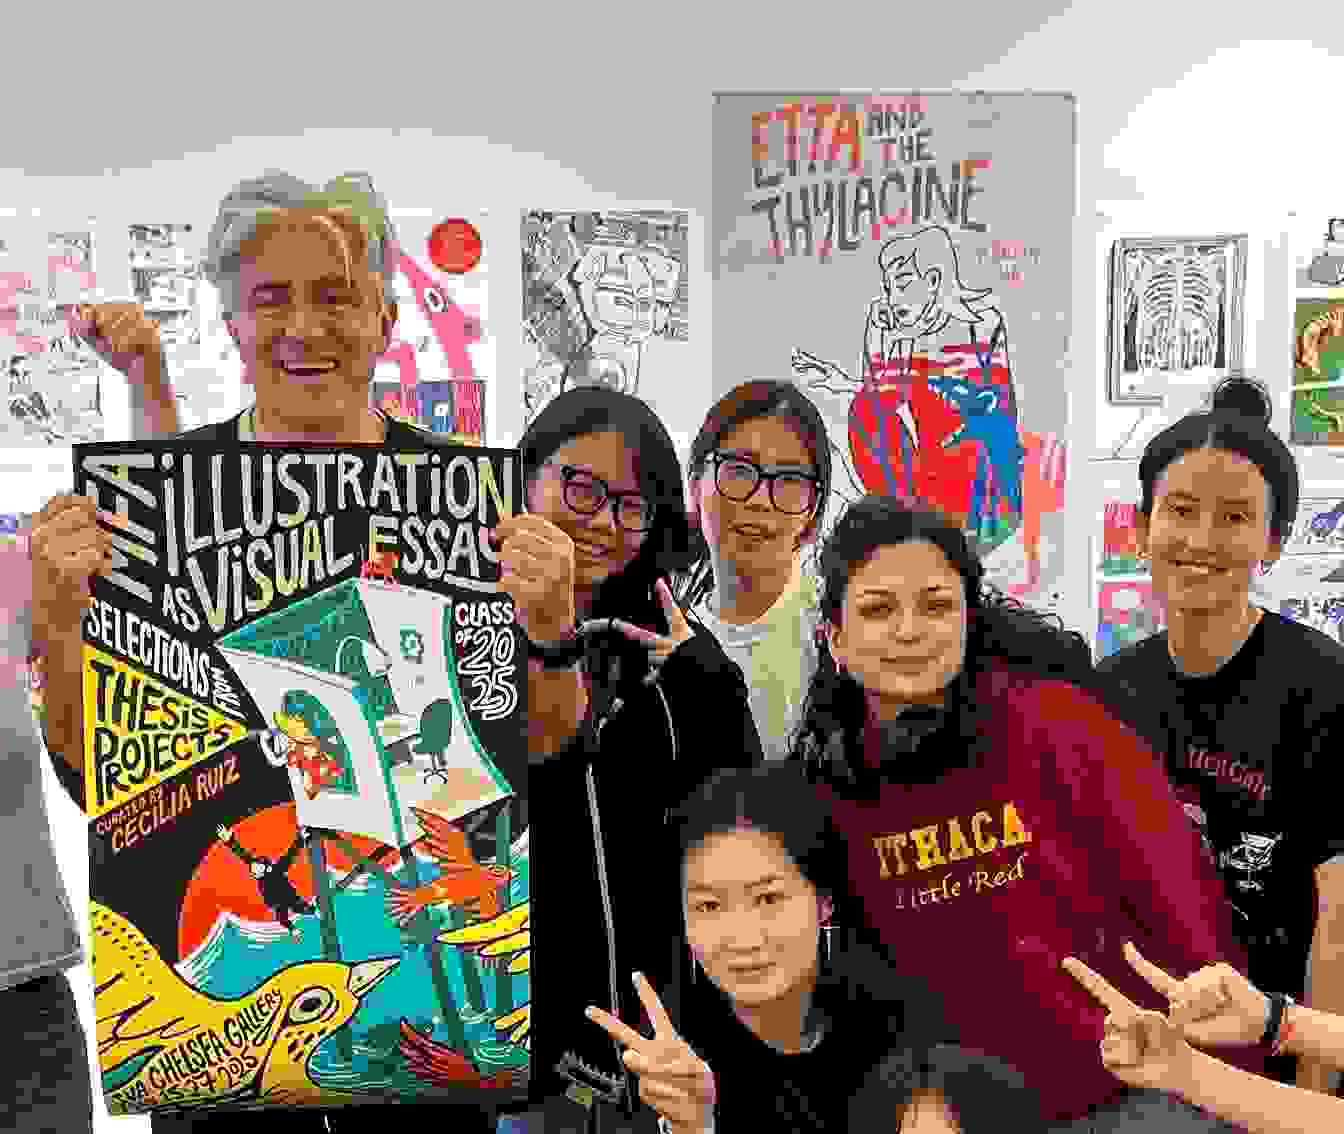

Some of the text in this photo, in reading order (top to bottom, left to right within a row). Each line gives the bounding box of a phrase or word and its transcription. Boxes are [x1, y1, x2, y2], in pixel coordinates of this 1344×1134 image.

[751, 100, 864, 188] ETTA
[872, 129, 935, 172] THE
[751, 160, 987, 264] THYLACINE
[162, 583, 202, 633] AS
[456, 601, 514, 626] CLASS
[96, 724, 233, 806] PROJECTS
[112, 756, 241, 850] CECILIA RUIZ
[872, 801, 1032, 880] ITHACA
[968, 853, 1028, 895] Red
[149, 1029, 230, 1089] CHELSEA
[224, 990, 283, 1046] GALLERY
